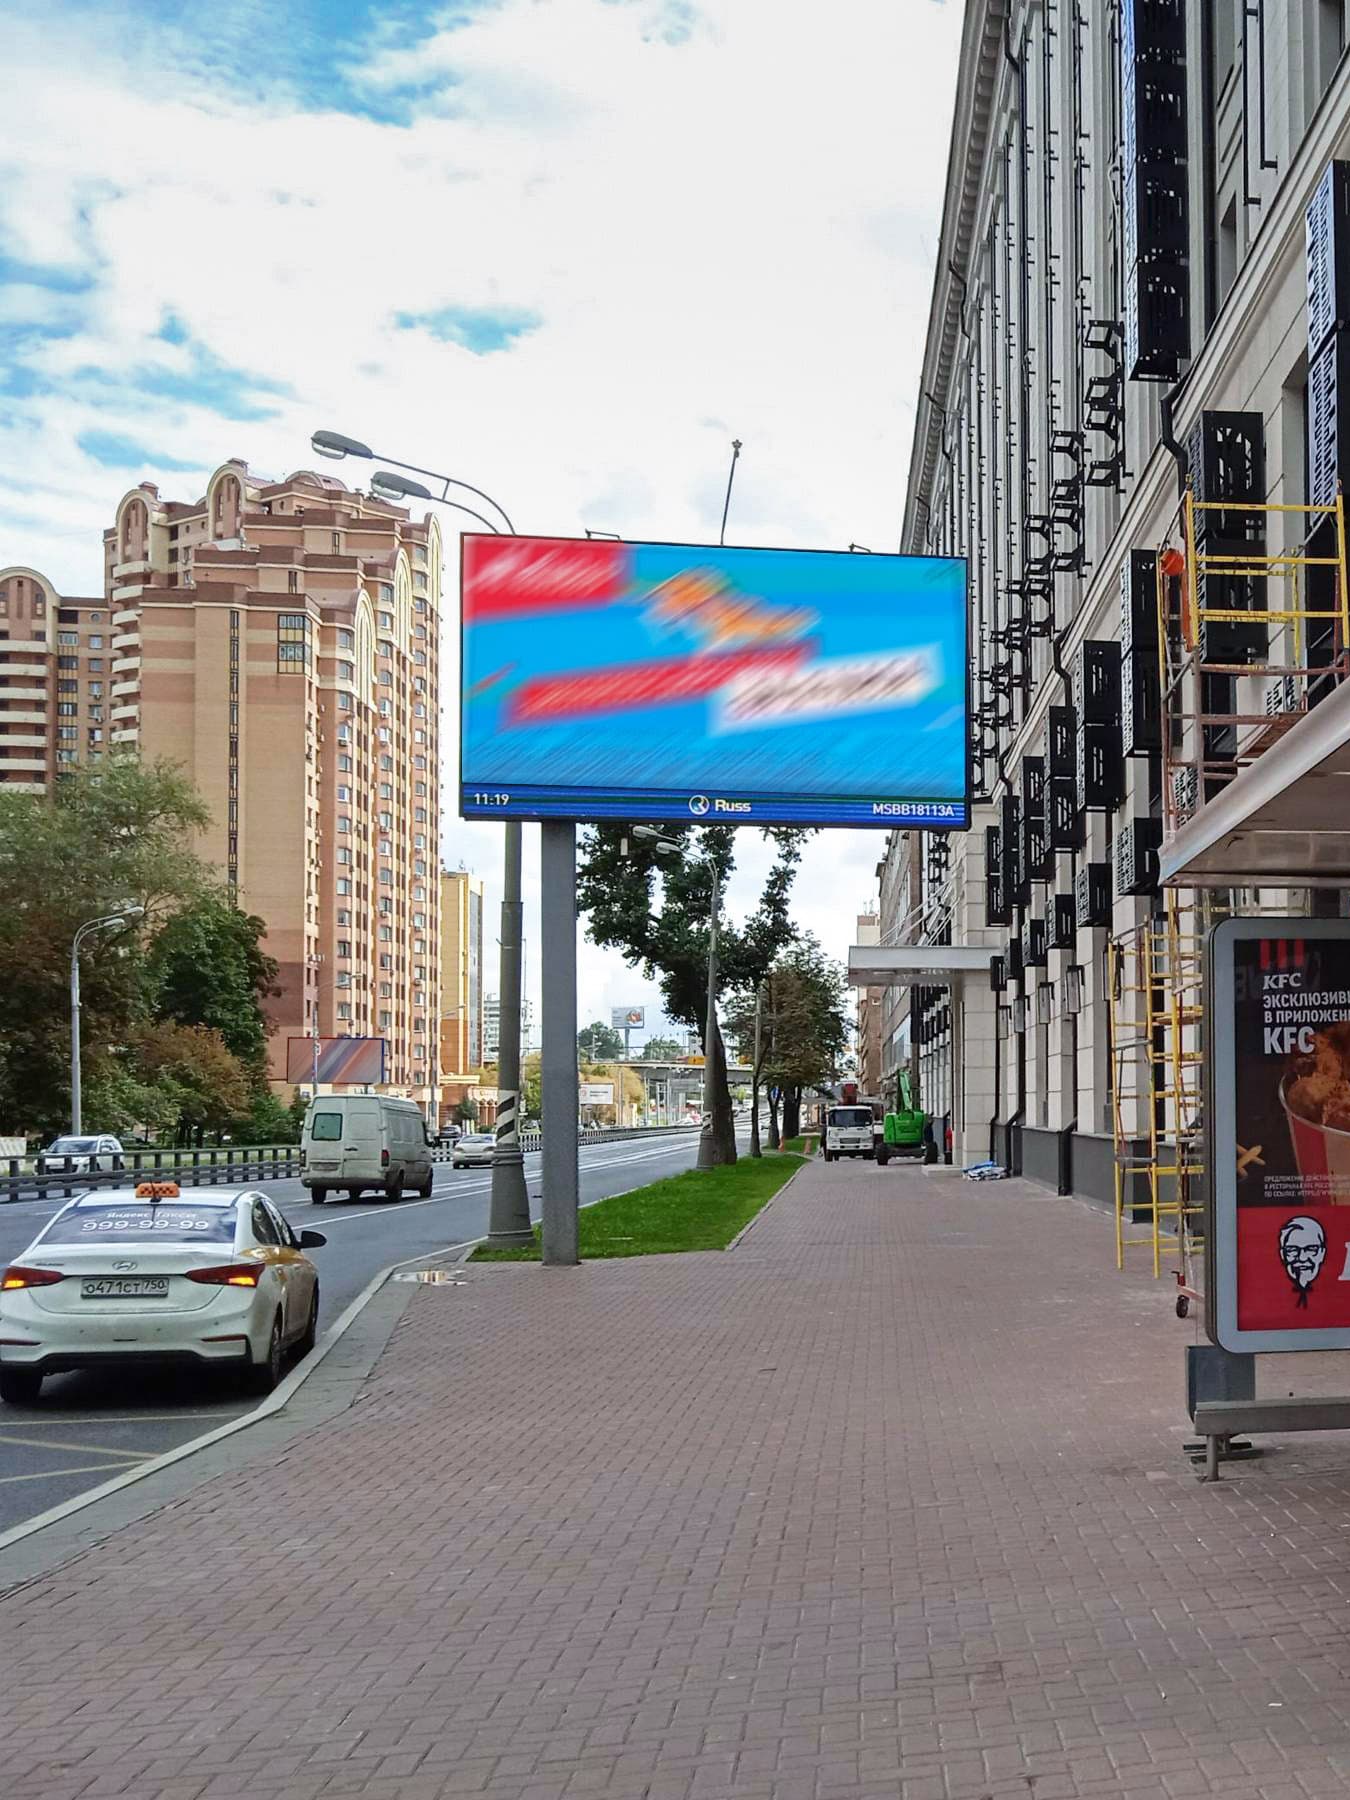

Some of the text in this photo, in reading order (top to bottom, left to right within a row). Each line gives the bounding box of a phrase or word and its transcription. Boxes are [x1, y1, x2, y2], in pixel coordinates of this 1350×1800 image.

[473, 792, 509, 807] 11:19
[714, 800, 752, 814] Russ
[872, 803, 955, 818] MSBB18113A
[1262, 972, 1302, 990] KFC
[1264, 1011, 1273, 1024] В
[1263, 1026, 1316, 1055] KFC
[81, 1219, 209, 1232] 999-99-99
